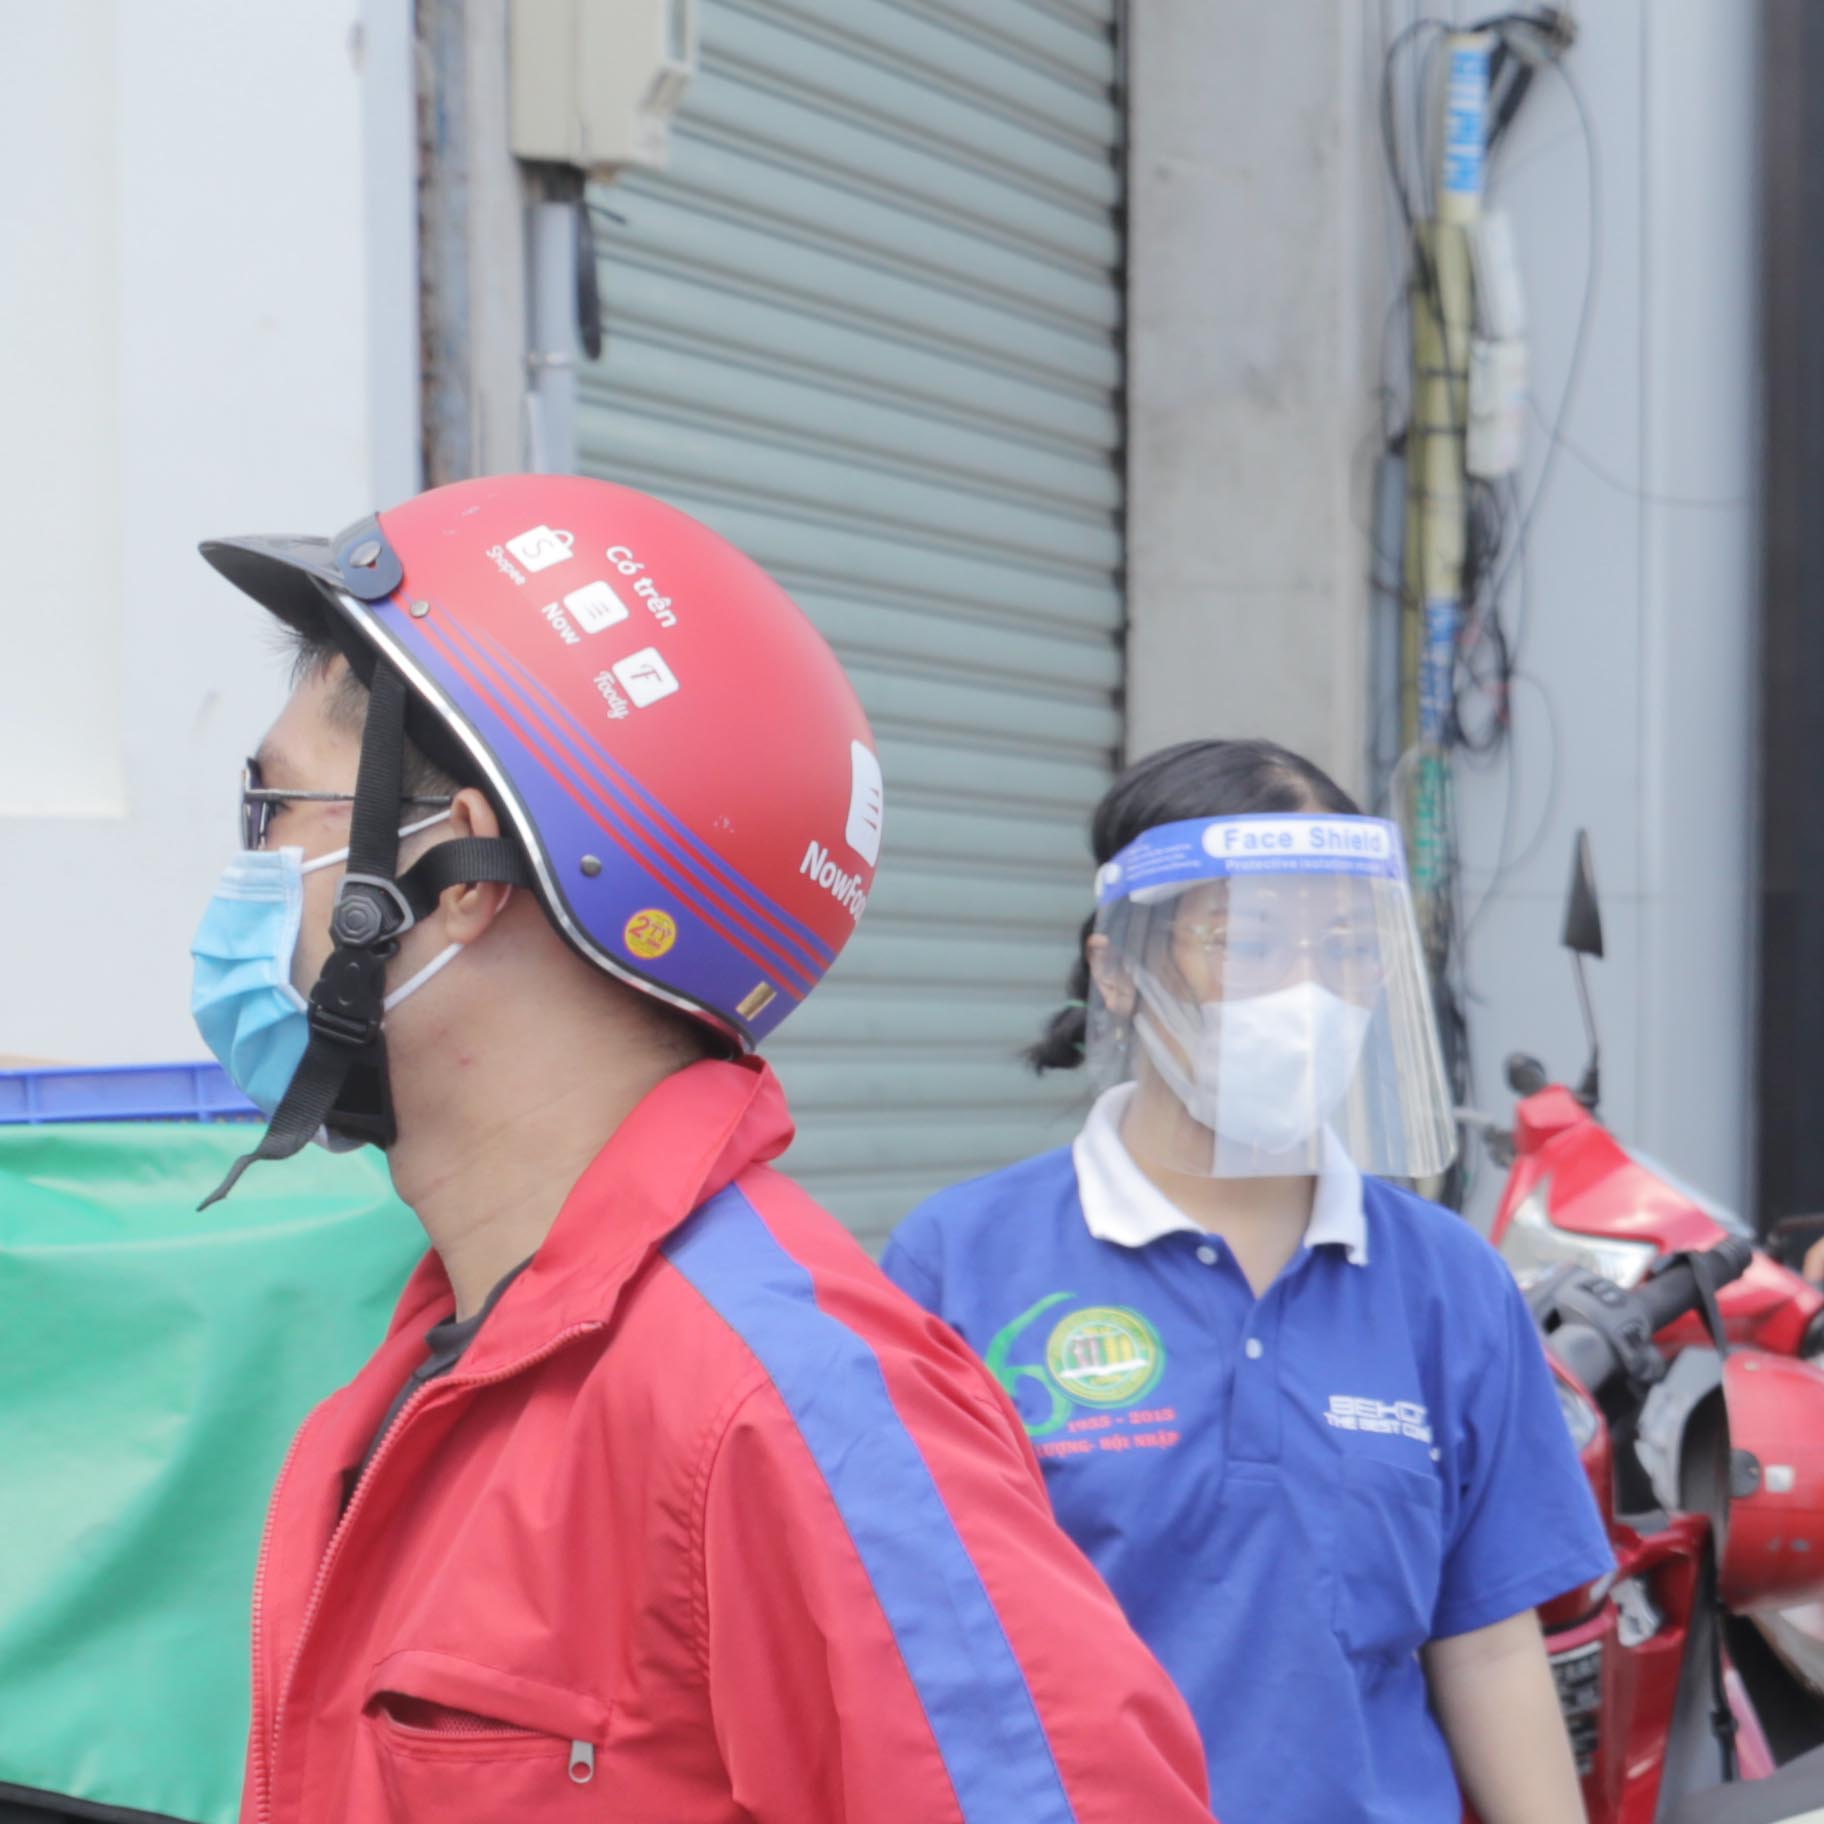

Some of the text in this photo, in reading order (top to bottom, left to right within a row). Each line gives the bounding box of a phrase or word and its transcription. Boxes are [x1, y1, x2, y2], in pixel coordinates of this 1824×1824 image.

[486, 545, 526, 586] Shopee
[605, 545, 678, 628] Có trên
[541, 602, 582, 645] Now
[593, 670, 630, 720] Foody
[1223, 825, 1382, 853] Face Shield
[628, 915, 651, 938] 2
